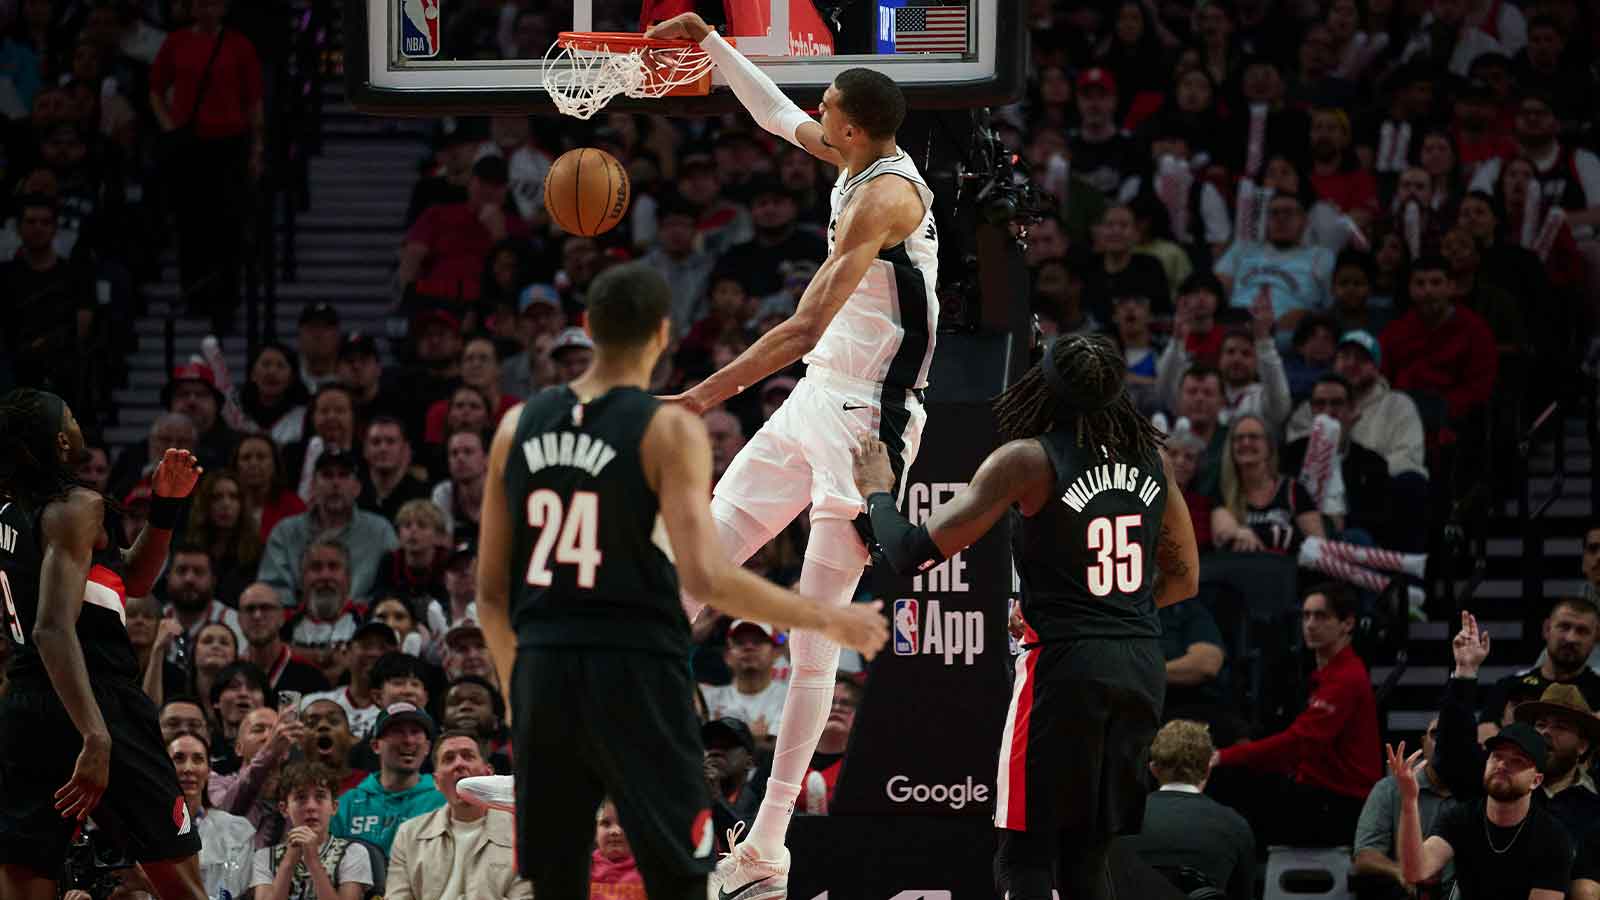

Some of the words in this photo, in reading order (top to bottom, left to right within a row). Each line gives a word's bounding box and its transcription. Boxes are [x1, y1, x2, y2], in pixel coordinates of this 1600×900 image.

[406, 37, 425, 51] NBA
[787, 32, 831, 56] tateFarm
[522, 431, 617, 478] MURRAY
[908, 482, 969, 527] GE
[1061, 463, 1140, 513] WILLIAMS
[1138, 475, 1161, 507] III
[526, 488, 604, 590] 24
[1086, 513, 1144, 597] 35
[921, 599, 985, 666] App
[886, 775, 989, 810] Google
